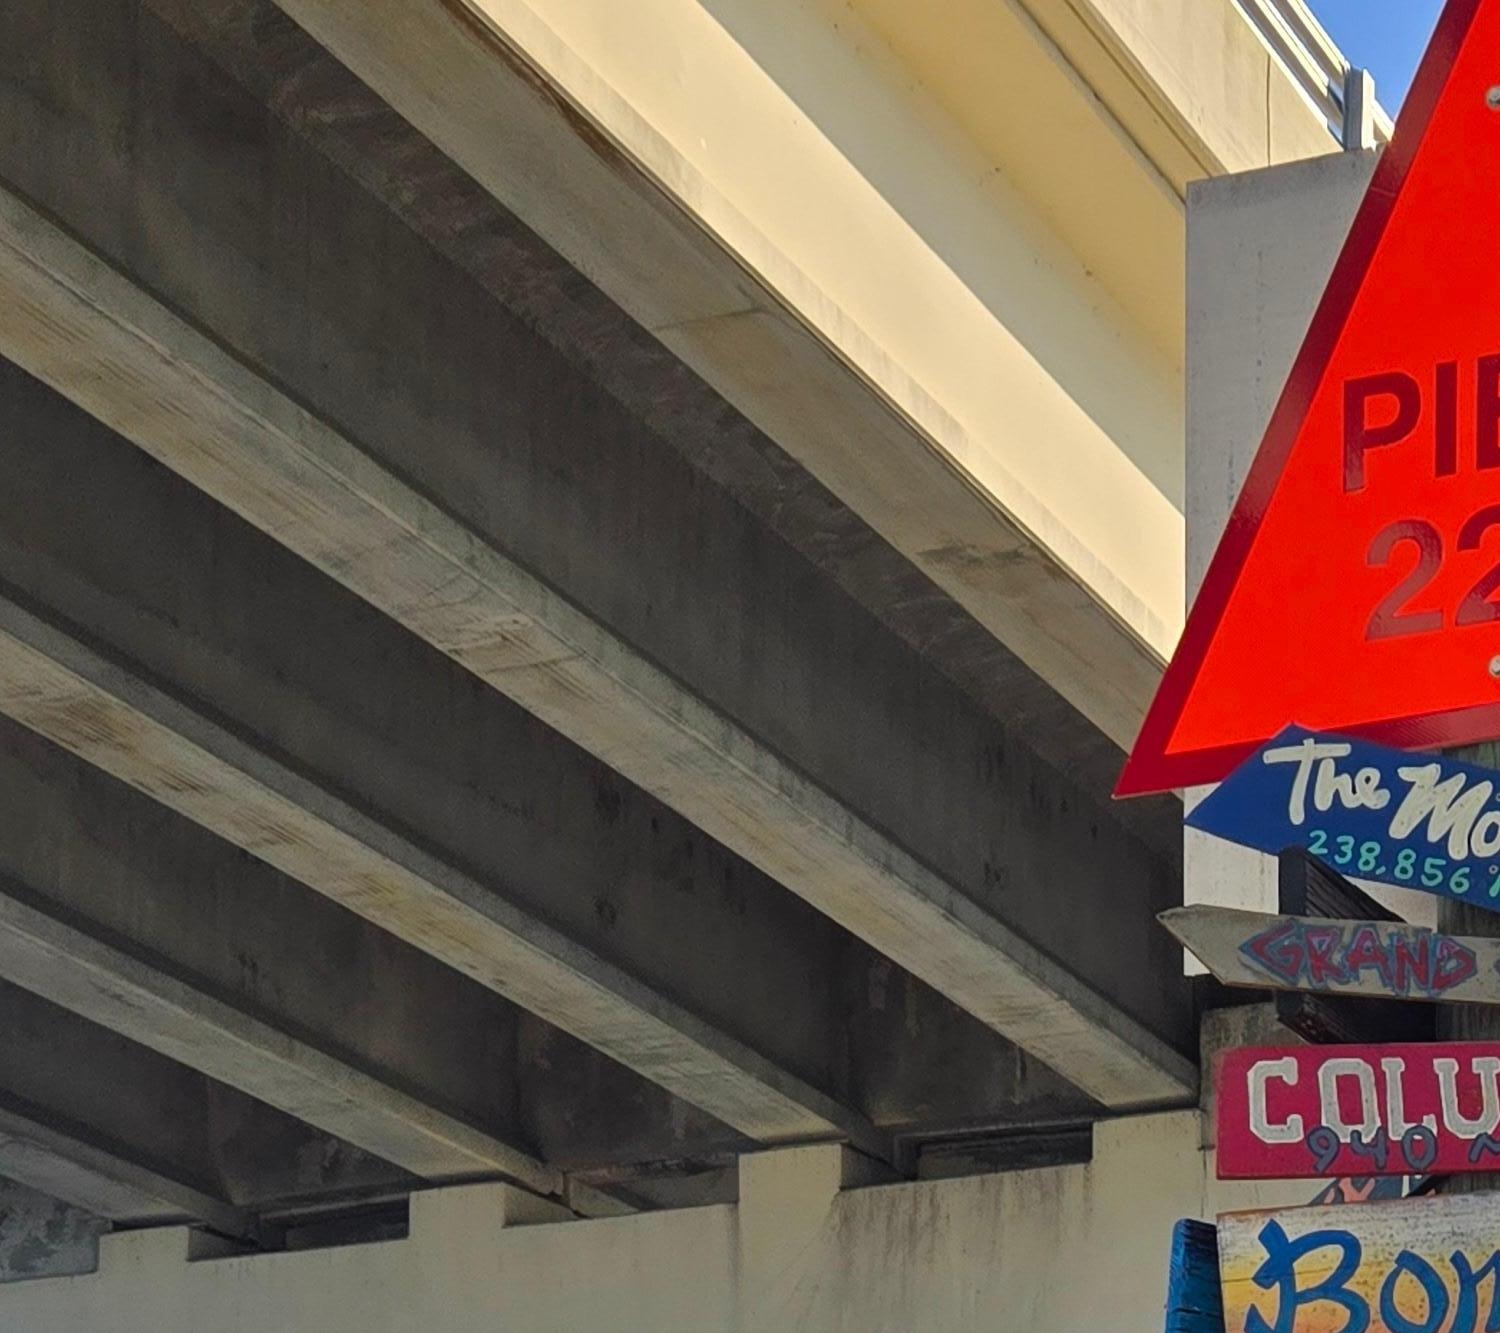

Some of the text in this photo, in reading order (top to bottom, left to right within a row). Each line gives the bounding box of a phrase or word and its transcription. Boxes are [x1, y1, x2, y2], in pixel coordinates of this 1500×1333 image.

[1262, 738, 1391, 826] The
[1306, 829, 1471, 895] 238,856
[1240, 917, 1478, 998] GRAND
[1307, 1126, 1439, 1173] 940
